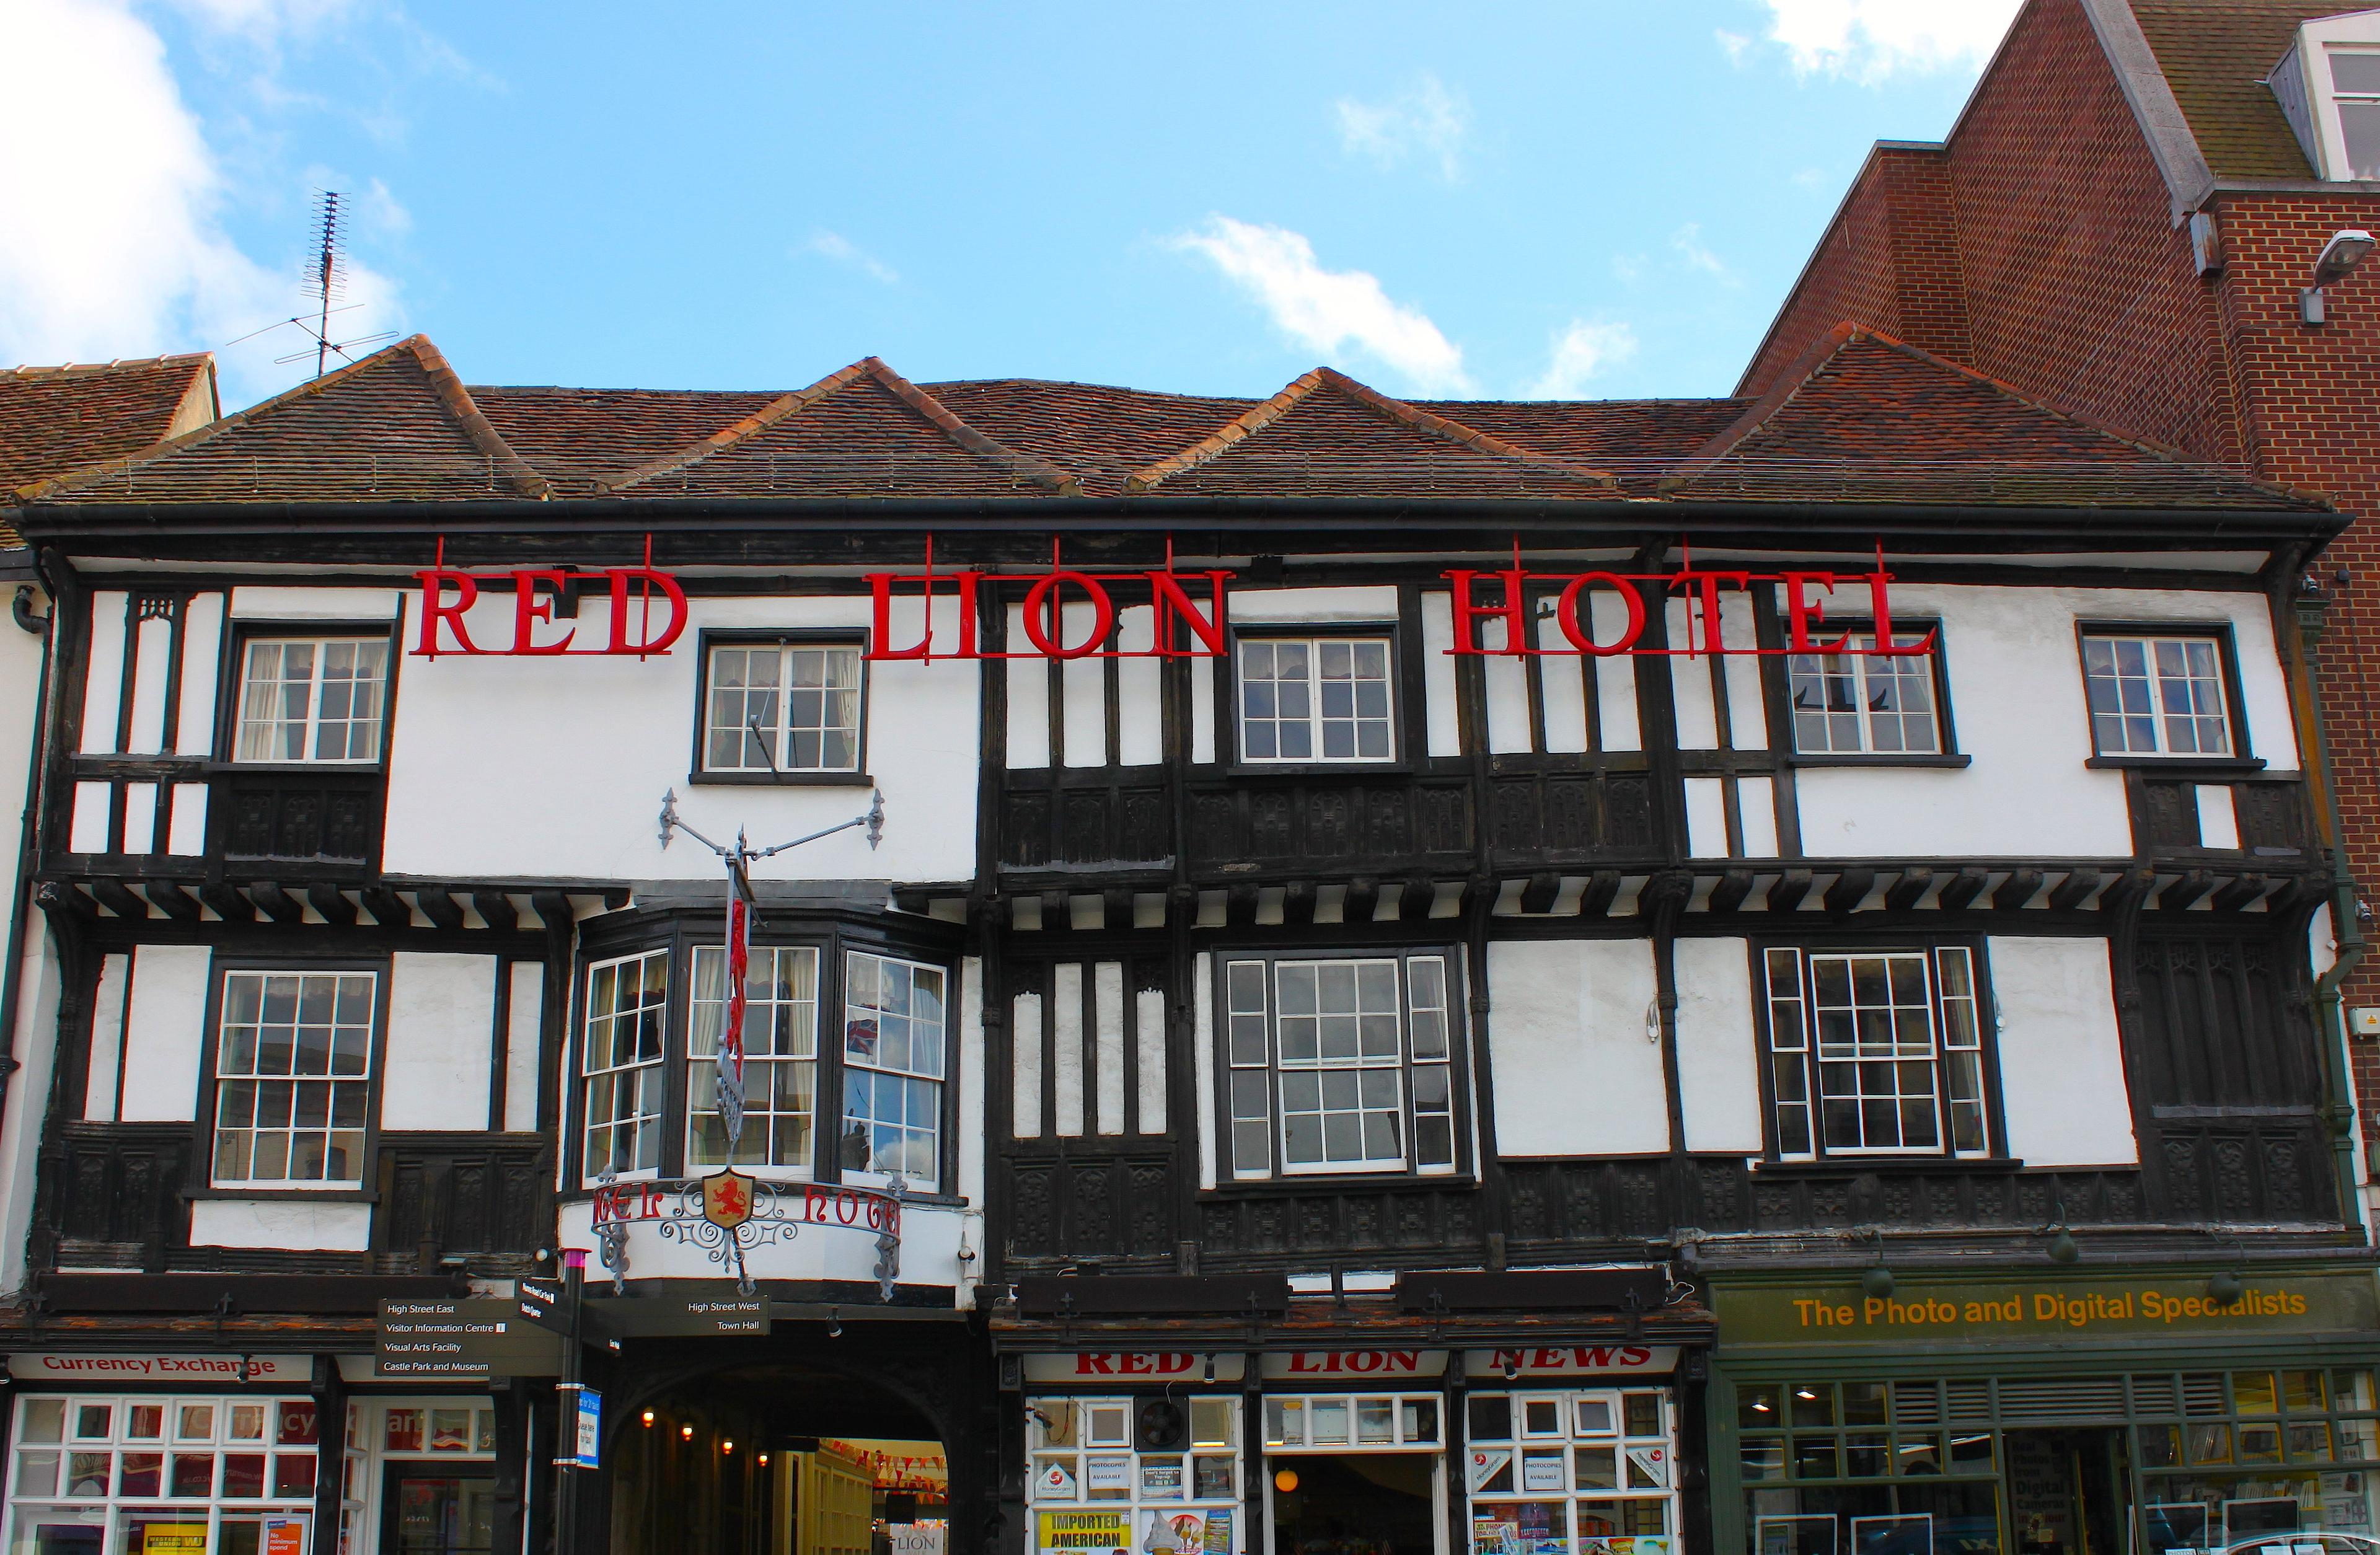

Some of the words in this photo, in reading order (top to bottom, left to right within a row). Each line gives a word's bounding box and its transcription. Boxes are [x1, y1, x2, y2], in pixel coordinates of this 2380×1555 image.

[410, 569, 688, 656] RED
[862, 570, 1232, 659] LION
[1443, 569, 1936, 658] HOTEL
[387, 1305, 407, 1315] High
[410, 1304, 434, 1314] Street
[437, 1305, 454, 1314] East
[688, 1303, 708, 1313] High
[710, 1302, 736, 1311] Street
[738, 1302, 760, 1311] West
[1793, 1299, 1854, 1327] The
[1864, 1298, 1957, 1325] Photo
[1964, 1294, 2023, 1322] and
[2034, 1292, 2134, 1326] Digital
[386, 1324, 413, 1333] Visitor
[415, 1324, 463, 1333] Information
[465, 1324, 494, 1333] Centre
[717, 1321, 740, 1330] Town
[743, 1321, 759, 1329] Hall
[385, 1343, 410, 1352] Visual
[413, 1343, 430, 1352] Arts
[432, 1342, 461, 1354] Facility
[43, 1355, 151, 1374] Currency
[160, 1357, 276, 1376] Exchange
[384, 1362, 410, 1371] Castle
[412, 1362, 431, 1371] Park
[433, 1362, 449, 1371] and
[451, 1362, 488, 1371] Museum
[1075, 1352, 1194, 1375] RED
[1287, 1350, 1422, 1373] LION
[1489, 1346, 1652, 1369] NEWS
[2012, 1441, 2035, 1452] Real
[2013, 1453, 2050, 1465] Photos
[2013, 1467, 2040, 1478] from
[2016, 1479, 2065, 1498] Digital
[2017, 1499, 2065, 1510] Cameras
[1052, 1514, 1121, 1530] IMPORTED
[897, 1535, 935, 1549] LION
[1051, 1532, 1121, 1548] AMERICAN
